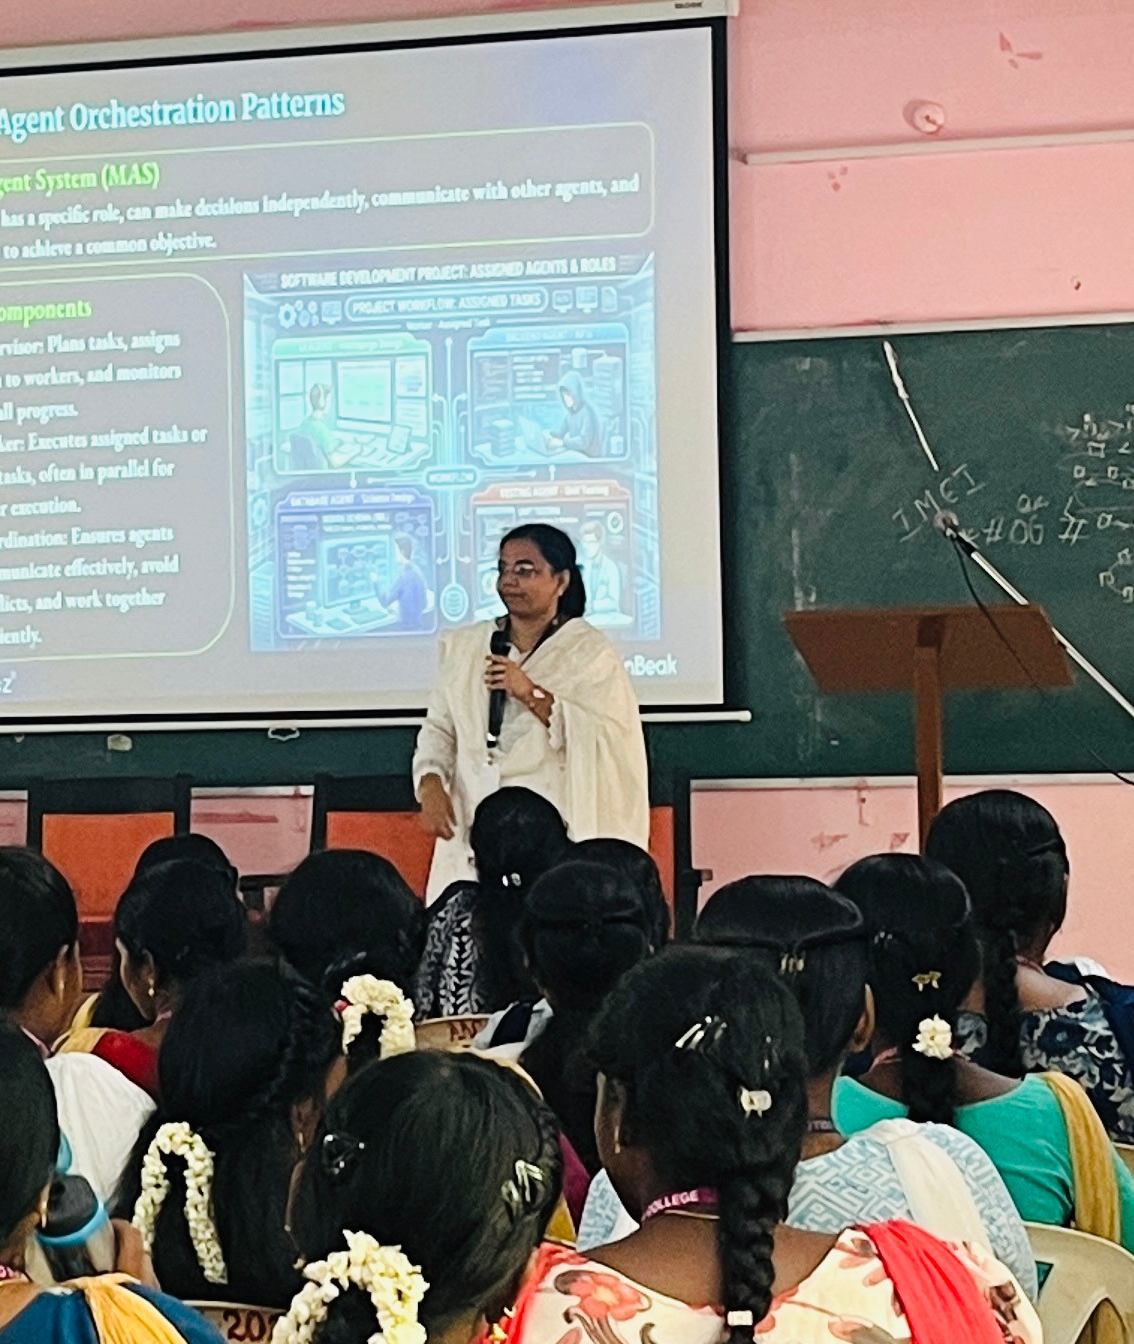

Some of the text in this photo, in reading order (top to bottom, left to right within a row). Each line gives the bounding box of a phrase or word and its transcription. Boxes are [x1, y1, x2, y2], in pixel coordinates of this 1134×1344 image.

[70, 94, 236, 132] Orchestration
[241, 91, 345, 120] Patterns
[35, 168, 97, 197] System
[101, 161, 160, 192] (MAS)
[0, 209, 25, 229] has
[28, 213, 35, 226] a
[38, 205, 89, 231] specific
[92, 203, 125, 225] role,
[126, 205, 152, 221] can
[155, 199, 193, 219] make
[195, 197, 260, 216] decisions
[262, 189, 369, 217] independently,
[371, 185, 470, 208] communicate
[473, 180, 509, 200] with
[510, 179, 551, 198] other
[554, 177, 607, 202] agents,
[610, 173, 641, 195] and
[3, 243, 19, 260] to
[21, 237, 72, 258] achieve
[75, 243, 84, 256] a
[86, 238, 148, 256] common
[149, 232, 217, 256] objective.
[339, 266, 417, 286] DEVELOPMENT
[525, 258, 569, 276] AGENTS
[581, 256, 616, 273] ROLES
[46, 333, 85, 354] Plans
[88, 330, 128, 352] tasks,
[130, 329, 181, 354] assigns
[5, 373, 21, 388] to
[23, 366, 84, 386] workers,
[87, 363, 113, 383] and
[116, 363, 182, 382] monitors
[16, 403, 79, 426] progress.
[27, 432, 88, 452] Executes
[90, 426, 149, 452] assigned
[152, 425, 188, 444] tasks
[191, 427, 208, 443] or
[38, 463, 76, 484] often
[79, 463, 94, 481] in
[97, 459, 149, 485] parallel
[152, 458, 175, 477] for
[10, 496, 82, 516] execution.
[71, 527, 126, 546] Ensures
[128, 526, 174, 549] agents
[64, 556, 139, 580] effectively,
[141, 554, 179, 575] avoid
[35, 591, 62, 611] and
[65, 589, 103, 609] work
[105, 587, 166, 613] together
